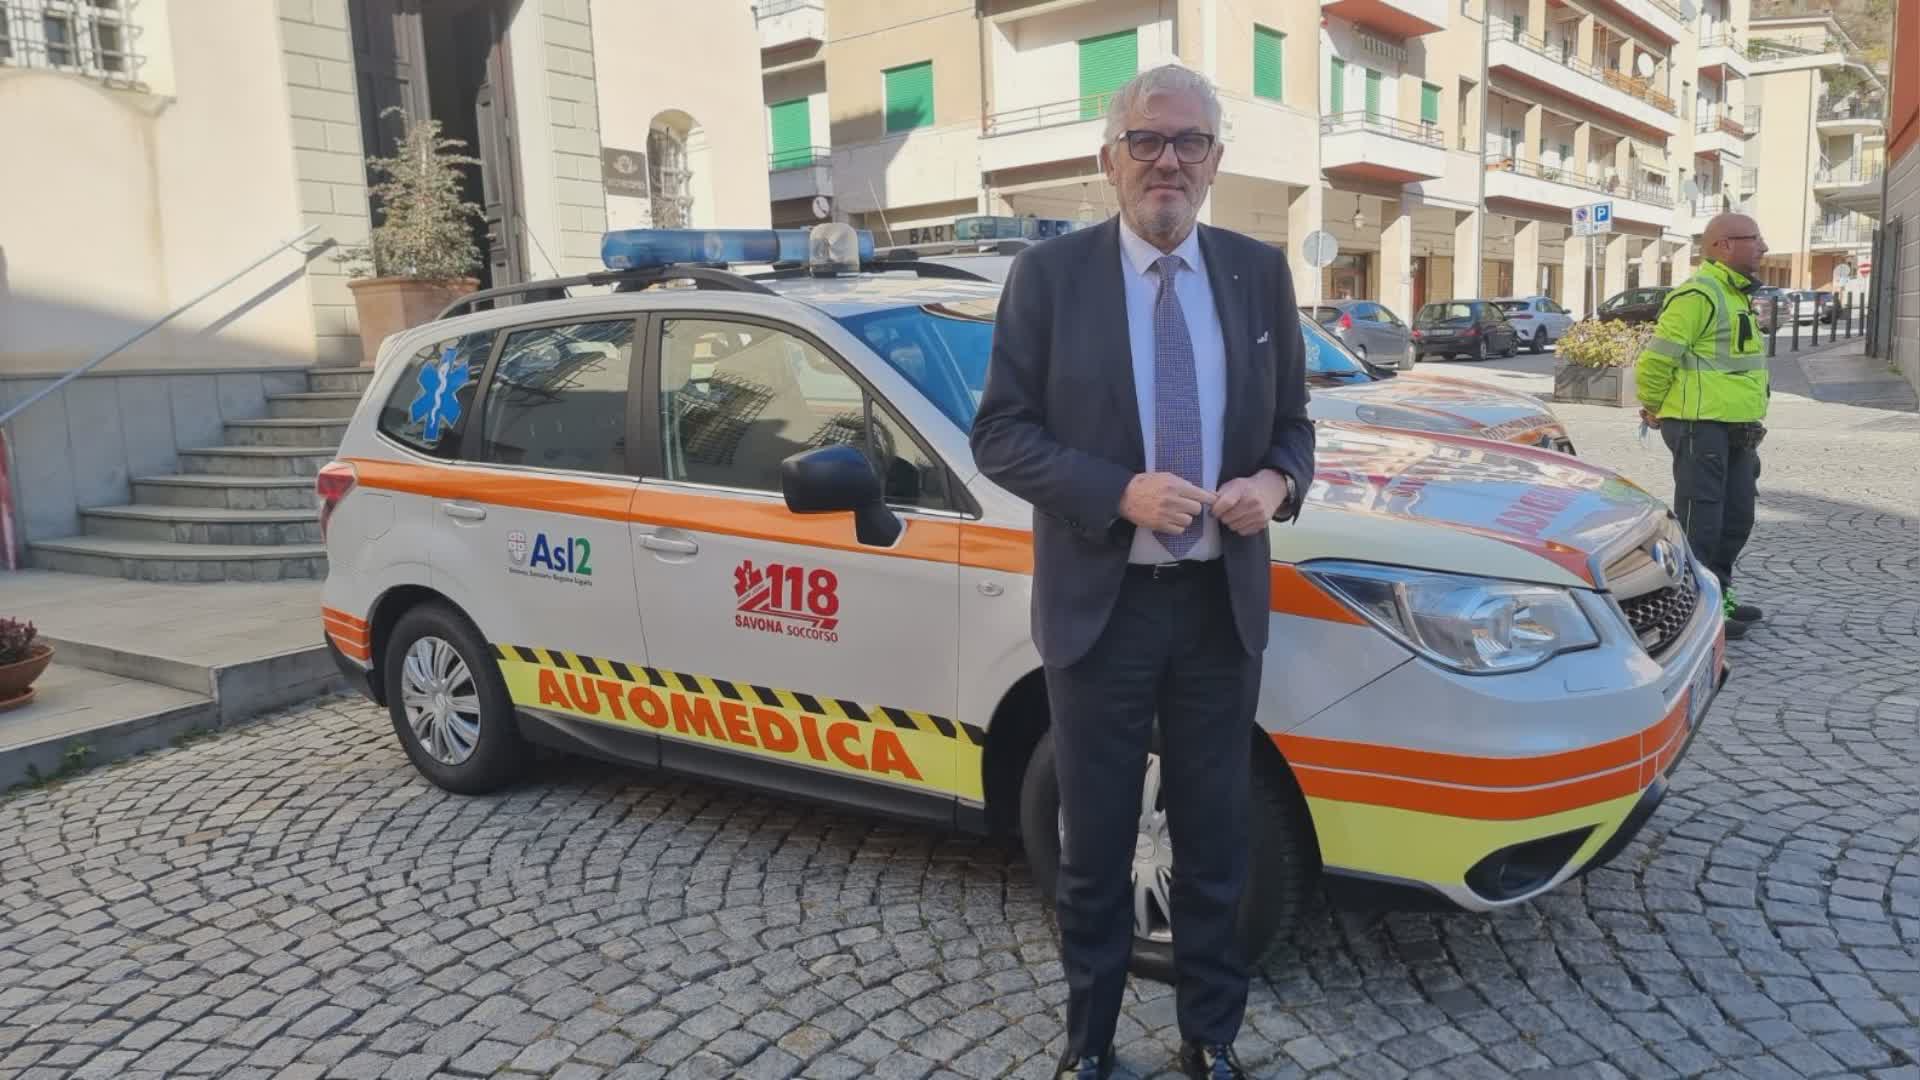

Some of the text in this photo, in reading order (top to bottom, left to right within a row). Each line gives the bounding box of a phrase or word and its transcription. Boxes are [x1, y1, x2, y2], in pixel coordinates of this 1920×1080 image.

[1597, 207, 1606, 220] P
[910, 226, 944, 244] BAR
[530, 533, 592, 575] Asl2
[766, 563, 840, 616] 118
[735, 614, 783, 634] SAVONA
[538, 669, 924, 781] AUTOMEDICA
